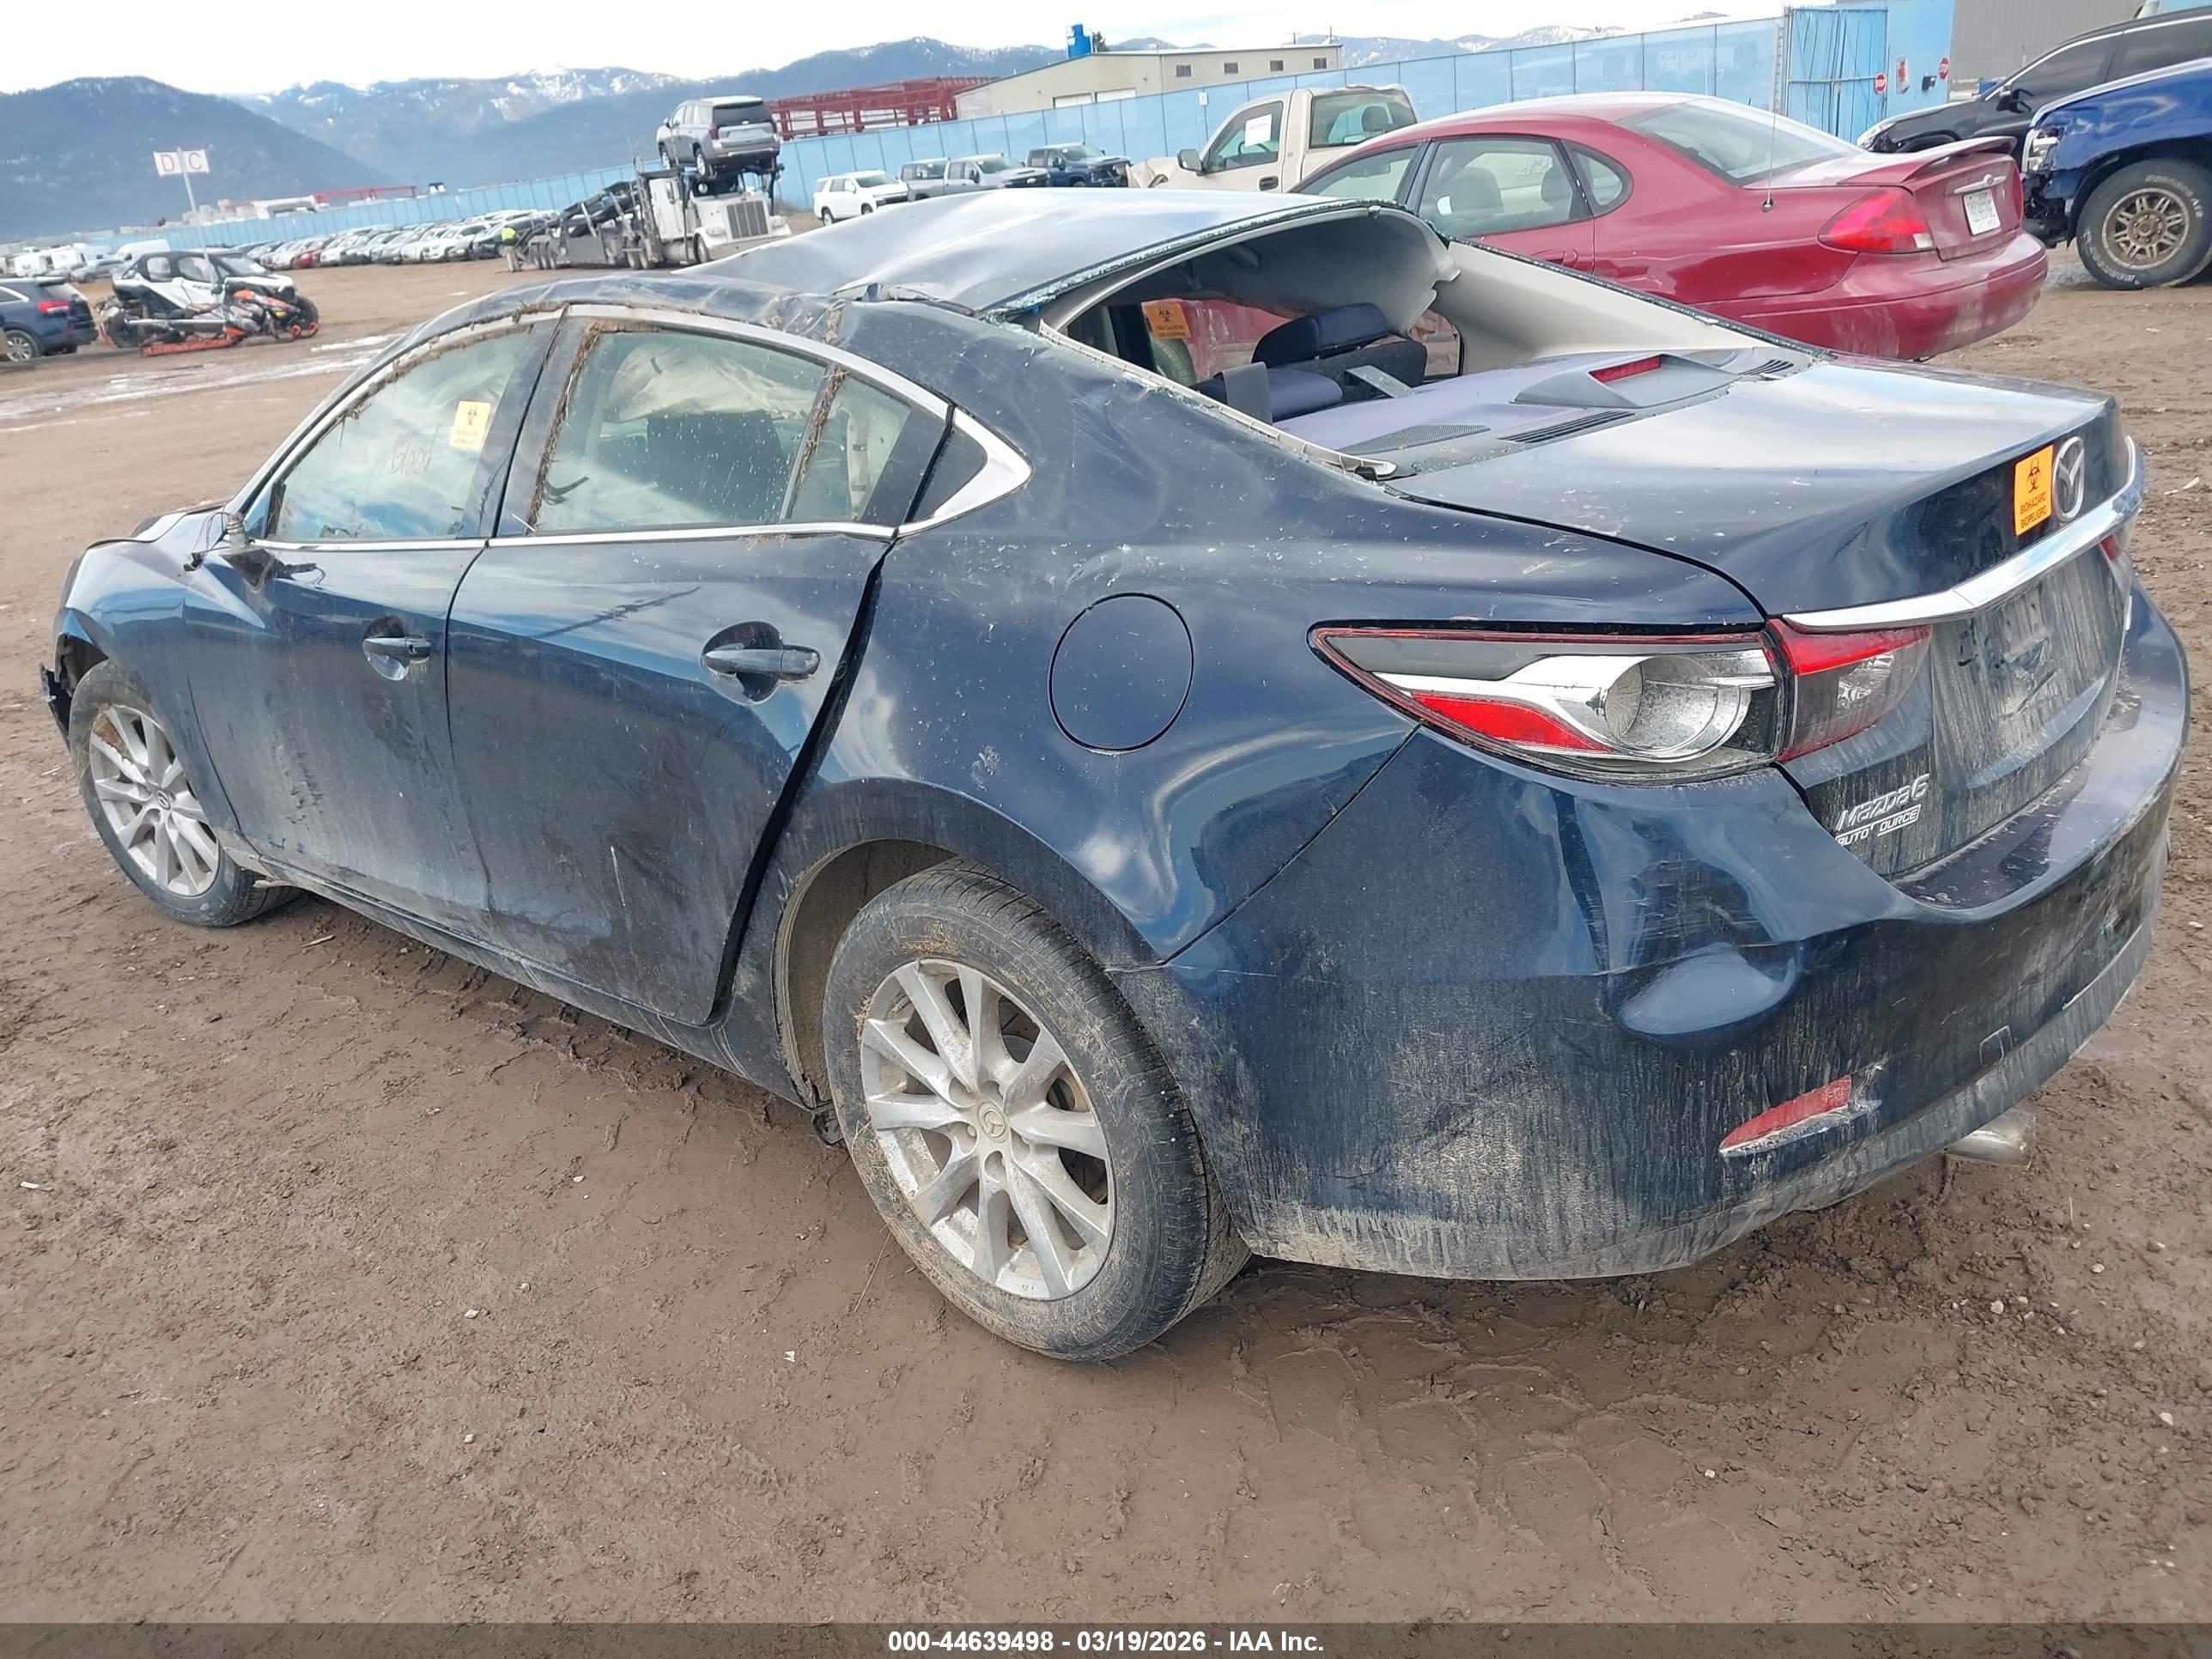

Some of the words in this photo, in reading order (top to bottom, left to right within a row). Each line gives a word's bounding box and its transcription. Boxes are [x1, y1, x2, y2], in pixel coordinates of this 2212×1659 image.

[161, 155, 174, 172] D
[189, 151, 203, 170] C
[1838, 827, 1869, 847] AUTO
